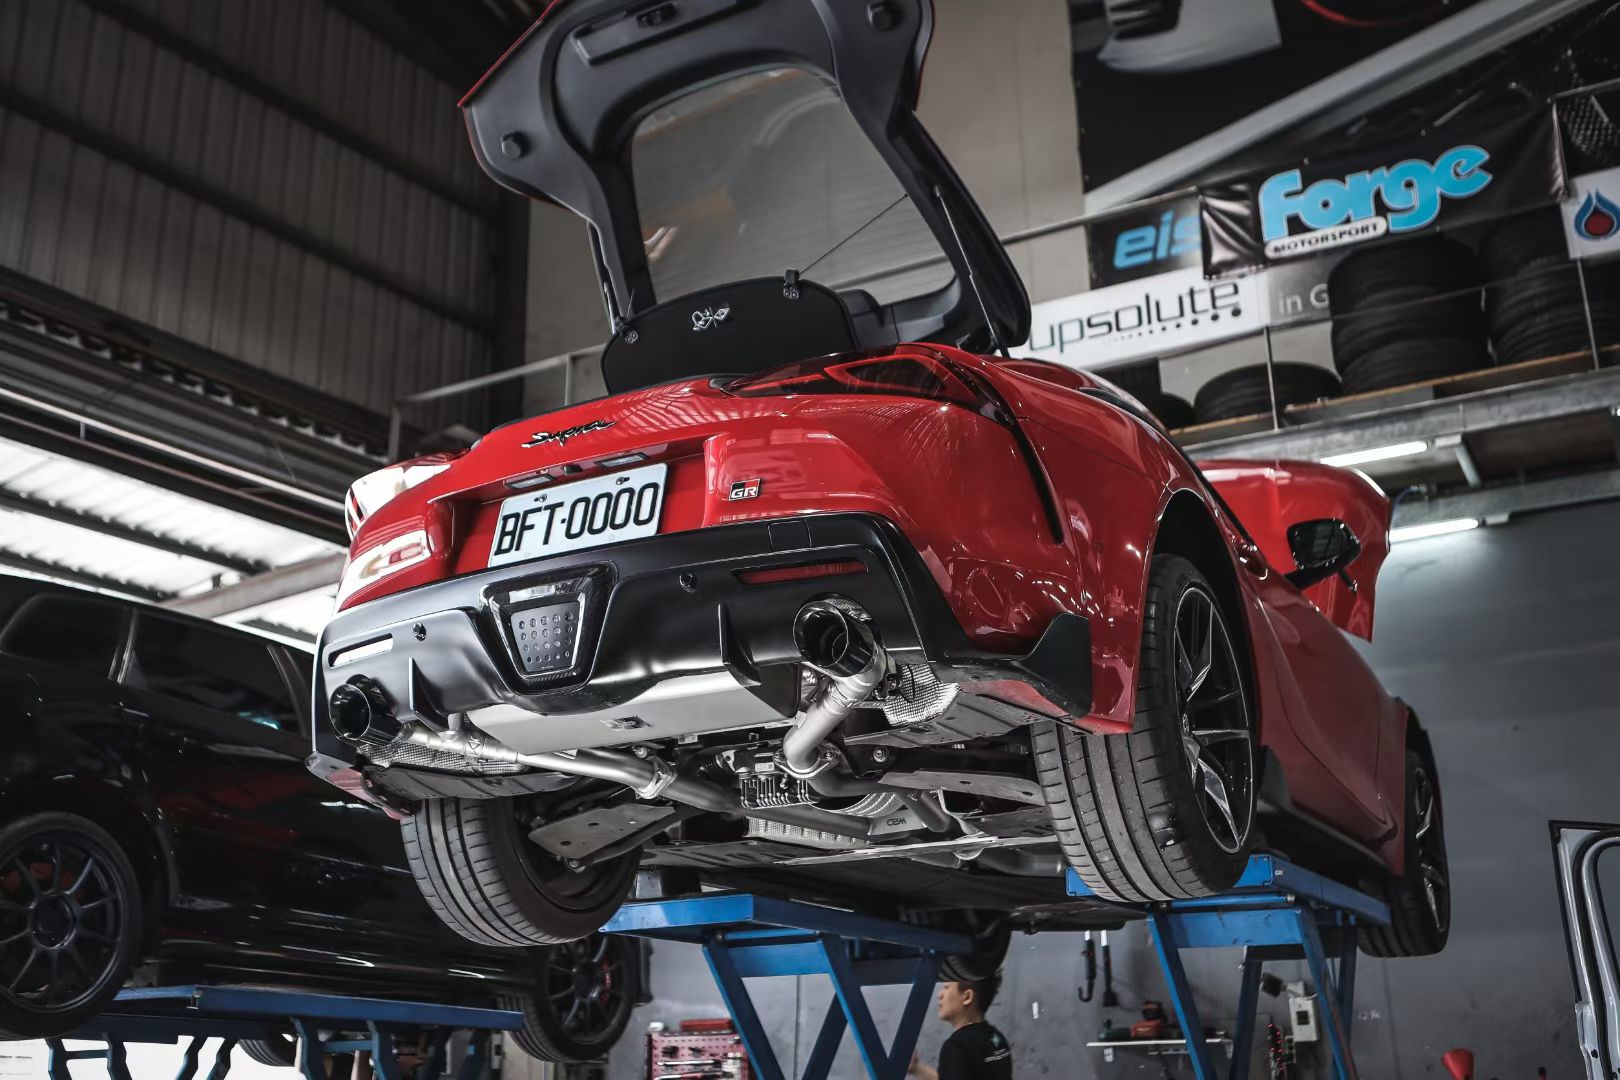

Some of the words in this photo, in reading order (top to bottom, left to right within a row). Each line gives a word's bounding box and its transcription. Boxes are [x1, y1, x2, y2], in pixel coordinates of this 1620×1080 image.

[1272, 221, 1379, 253] MOTORSPORT
[1279, 292, 1303, 314] in
[1029, 282, 1240, 353] upsolute
[521, 421, 617, 448] Supra
[731, 486, 757, 499] GR
